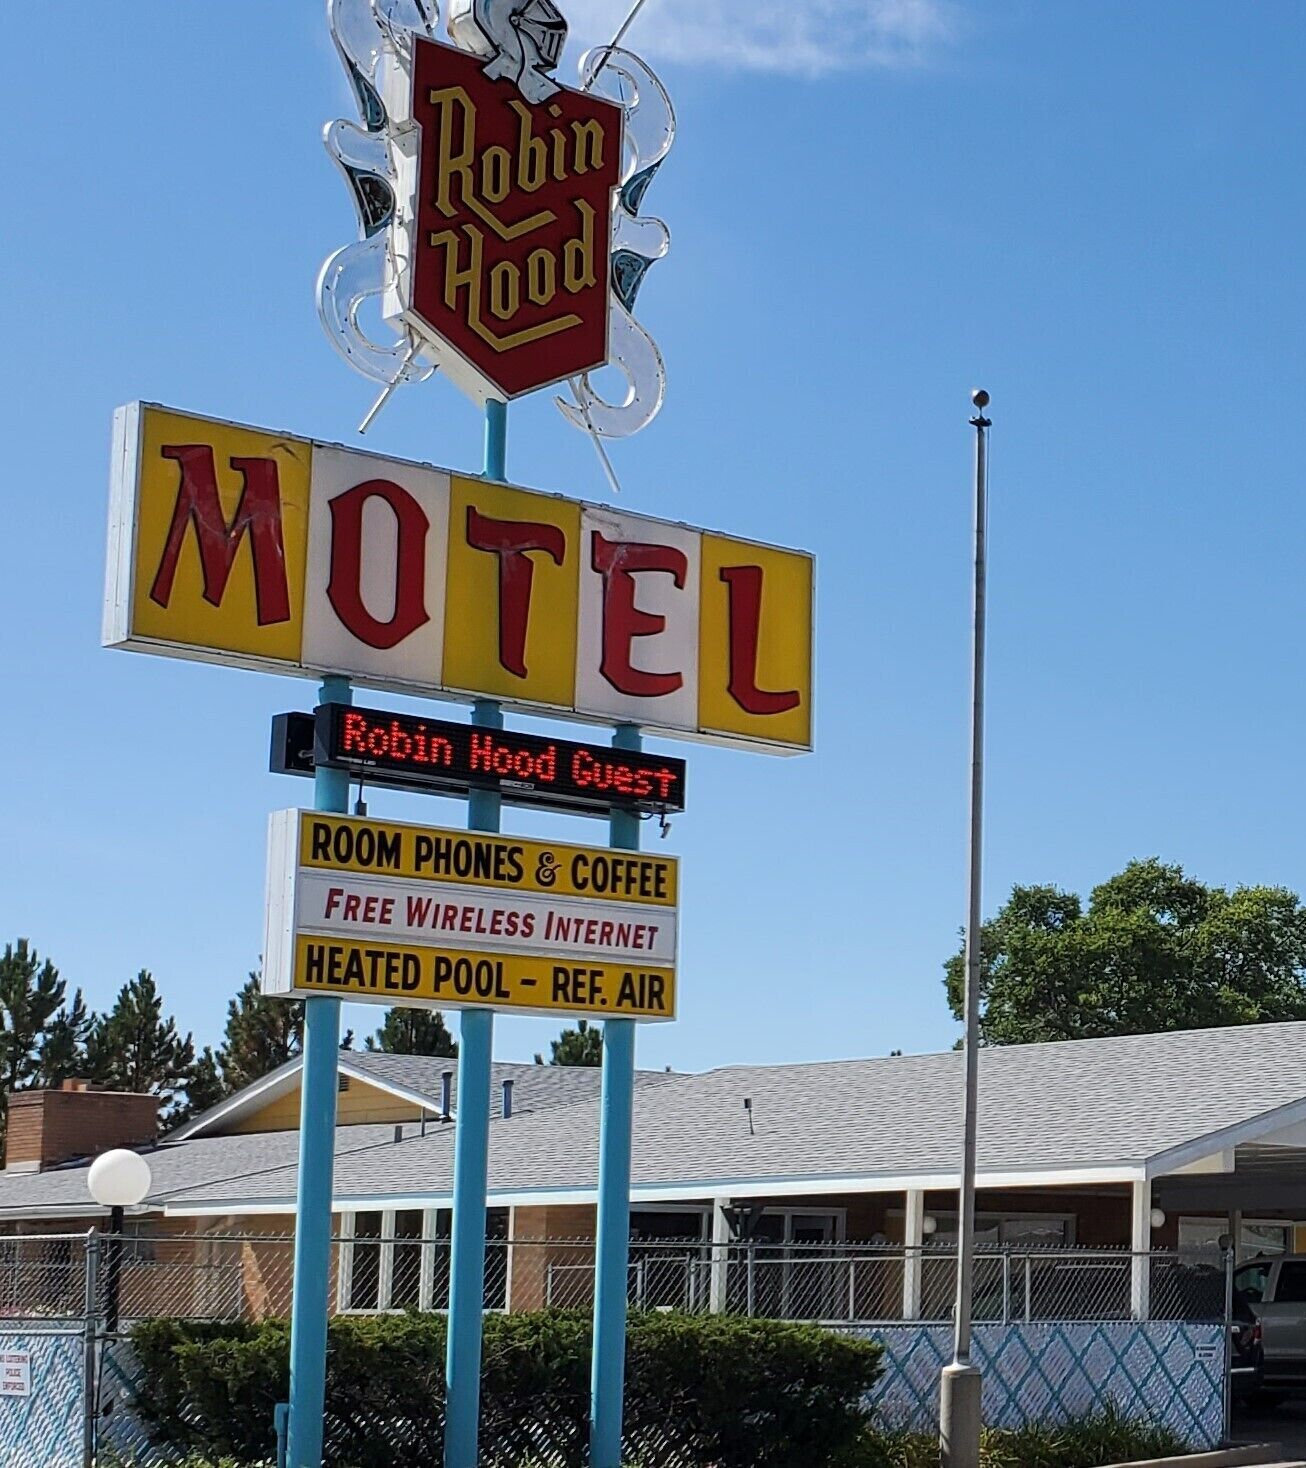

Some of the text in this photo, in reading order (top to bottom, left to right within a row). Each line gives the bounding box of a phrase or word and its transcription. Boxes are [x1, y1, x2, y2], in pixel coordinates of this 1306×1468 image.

[430, 88, 604, 240] Robin
[431, 200, 597, 350] Hood
[149, 444, 801, 714] MOTEL
[343, 712, 678, 798] Robin Hood Guest
[311, 822, 668, 899] ROOM PHONES & COFFEE
[324, 888, 658, 950] FREE WIRELESS INTERNET
[306, 944, 422, 990] HEATED
[434, 957, 511, 998] POOL
[552, 966, 608, 1006] REF.
[616, 972, 666, 1010] AIR
